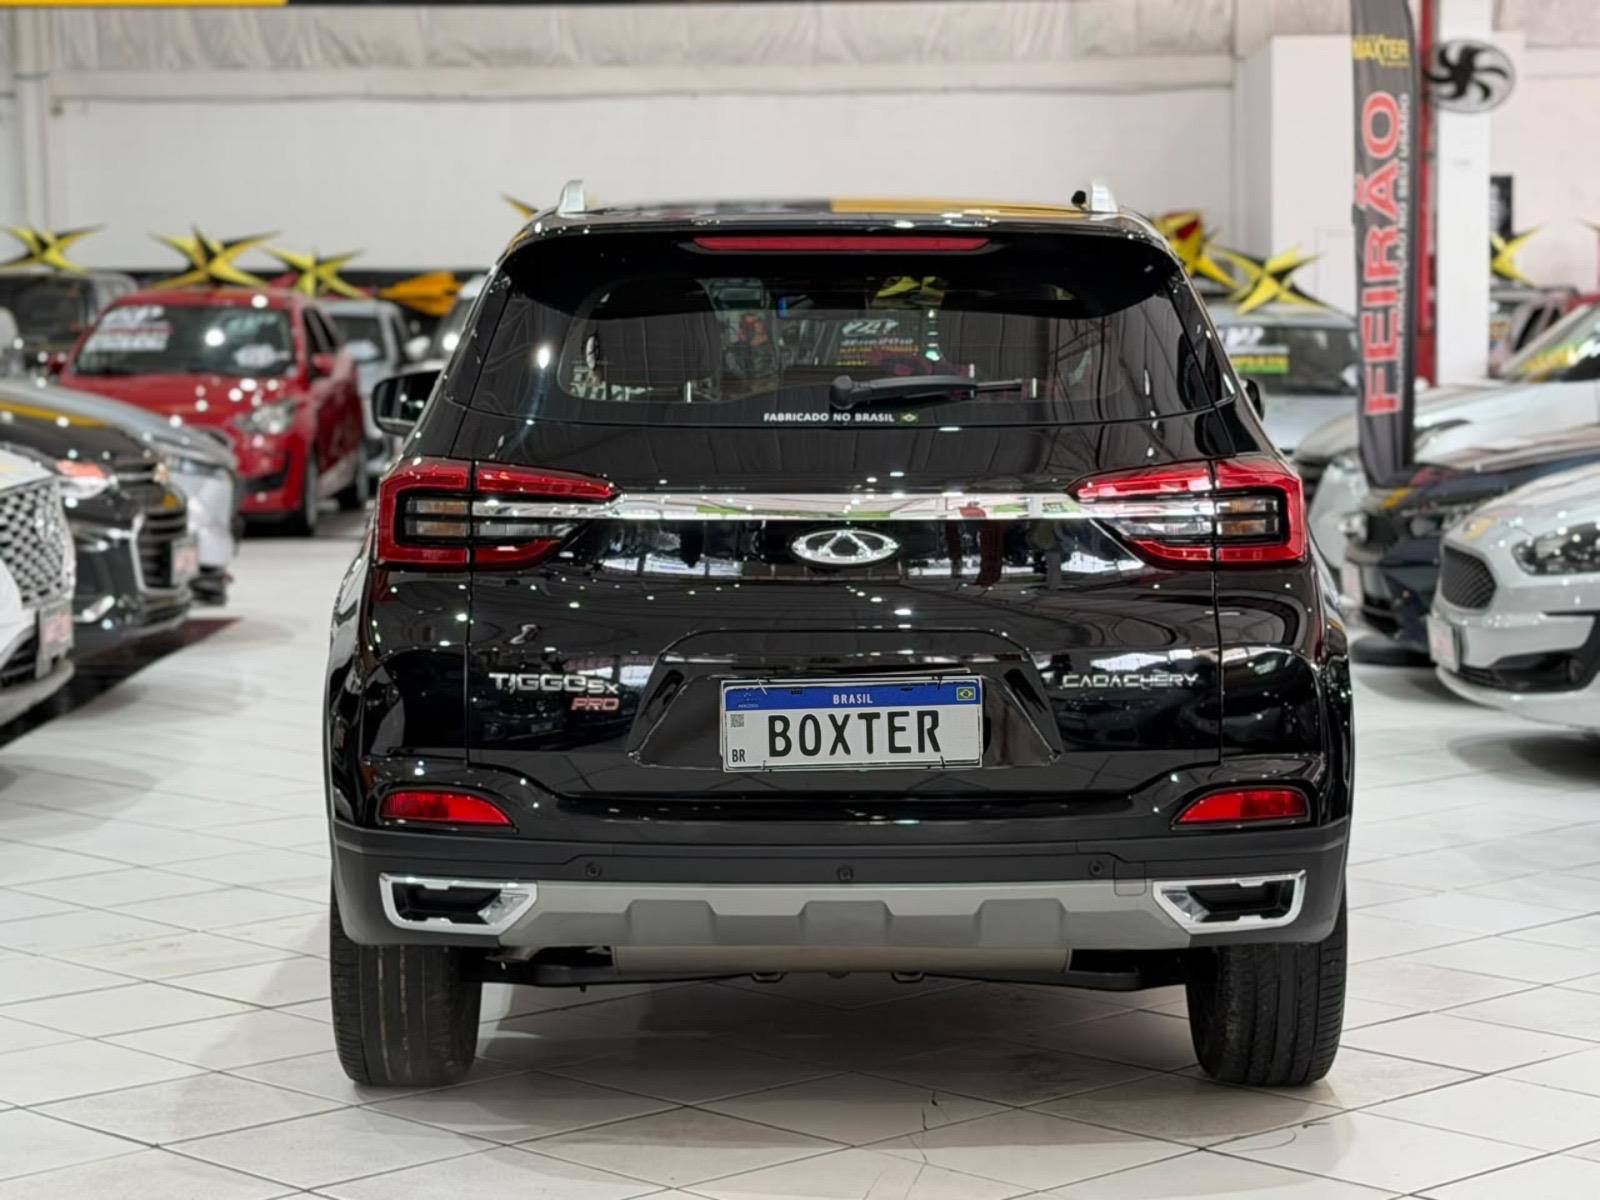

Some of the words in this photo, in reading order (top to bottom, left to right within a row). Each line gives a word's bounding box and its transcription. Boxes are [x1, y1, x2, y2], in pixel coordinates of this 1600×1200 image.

[1355, 91, 1401, 415] FEIRÃO
[763, 412, 830, 422] FABRICADO
[833, 412, 851, 422] NO
[854, 412, 896, 423] BRASIL
[571, 697, 620, 712] PRO
[832, 693, 874, 705] BRASIL
[767, 710, 942, 757] BOXTER
[731, 748, 746, 763] BR
